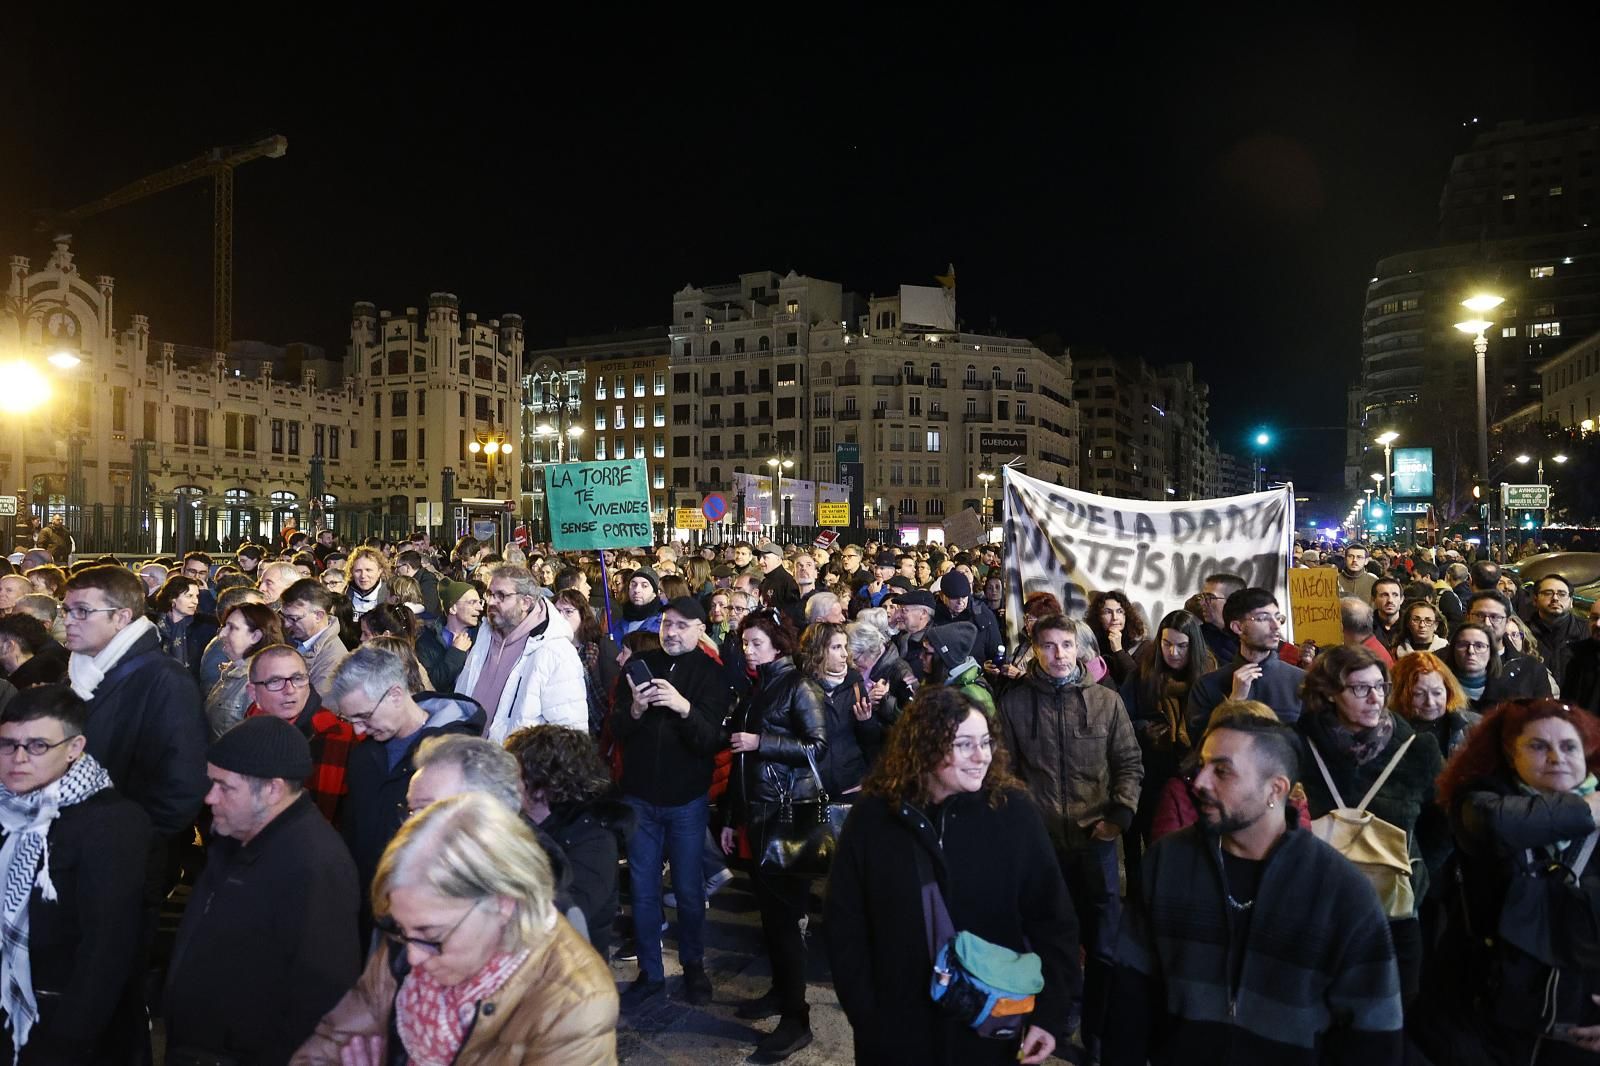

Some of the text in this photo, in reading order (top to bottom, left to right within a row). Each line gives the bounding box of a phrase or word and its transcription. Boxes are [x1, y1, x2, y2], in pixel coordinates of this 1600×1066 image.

[600, 359, 656, 372] HOTEL ZENIT
[982, 438, 1019, 447] GUEROLA
[552, 465, 632, 488] LA TORRE
[574, 487, 594, 505] TÉ
[589, 501, 648, 516] VIVENDES
[561, 521, 648, 538] SENSE PORTES
[1113, 510, 1157, 542] LA
[1291, 571, 1333, 599] MAZÓN
